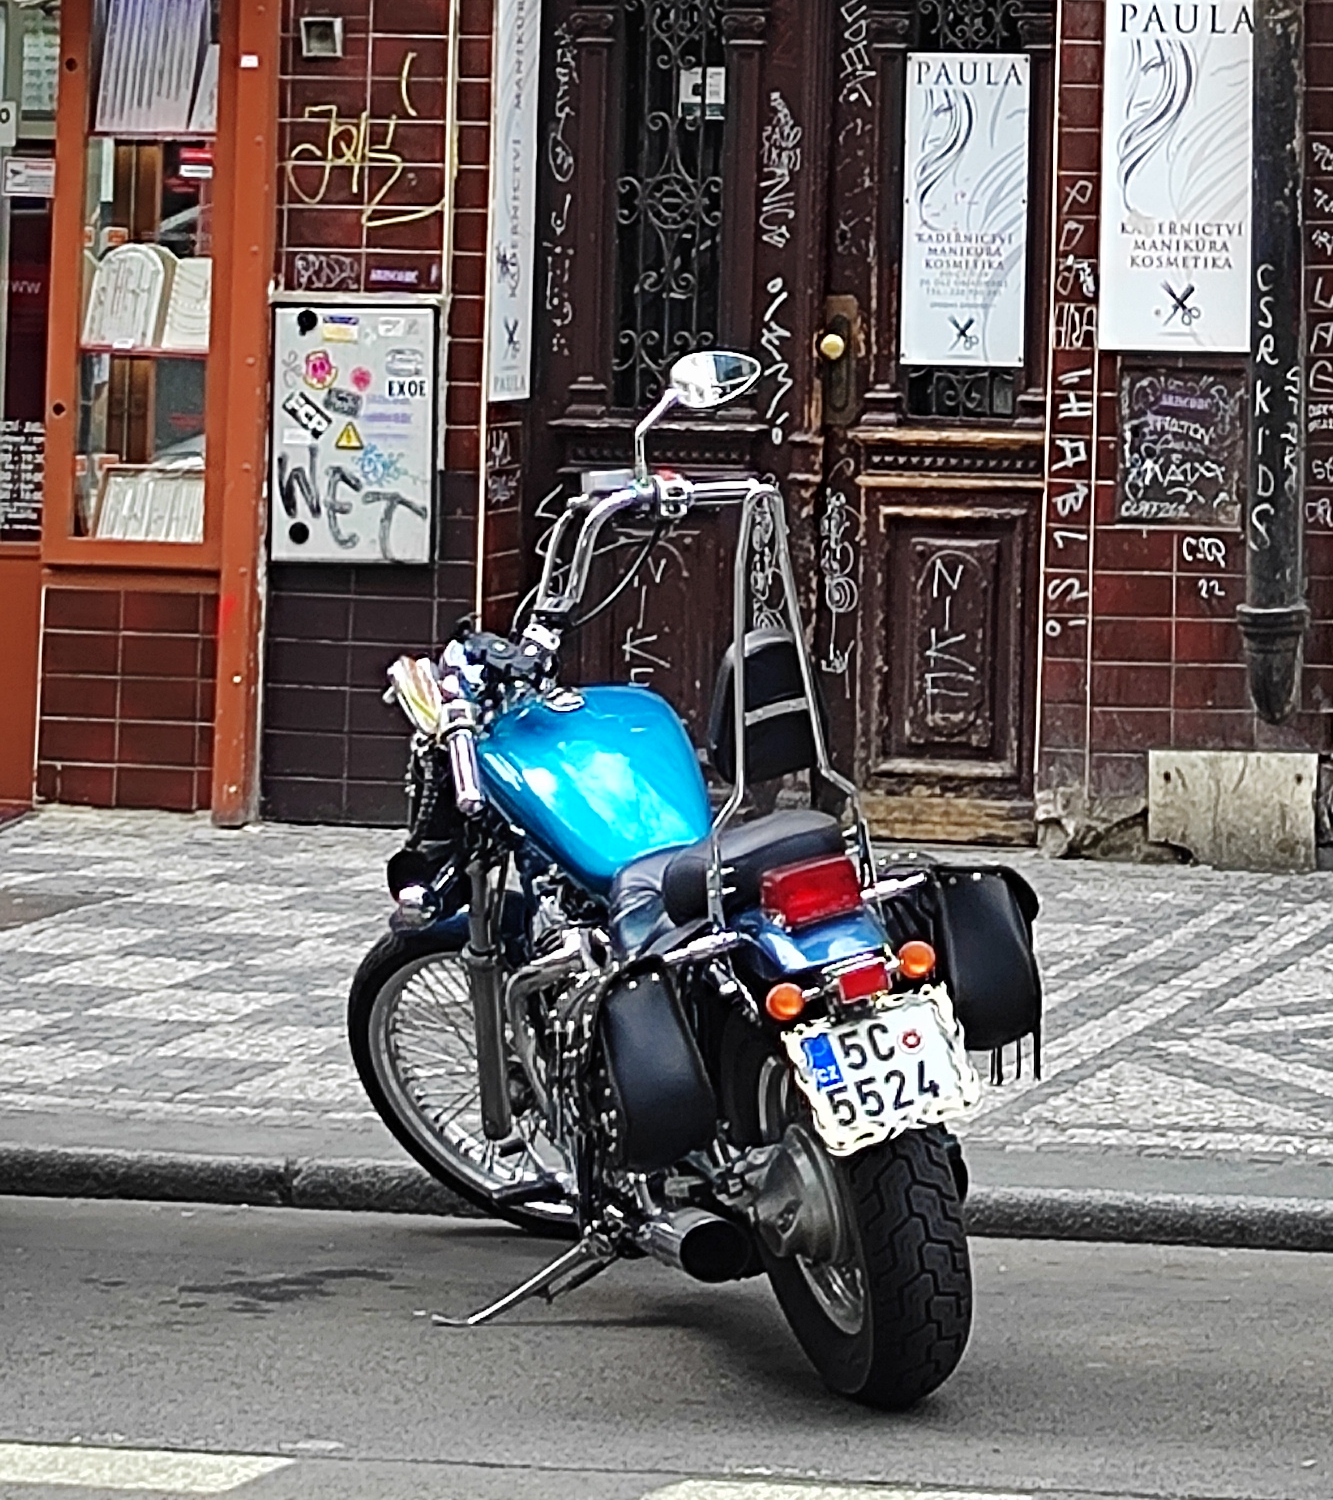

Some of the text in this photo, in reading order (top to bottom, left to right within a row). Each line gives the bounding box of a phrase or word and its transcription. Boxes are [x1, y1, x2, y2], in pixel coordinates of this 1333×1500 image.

[1119, 3, 1255, 35] PAULA
[915, 60, 1024, 88] PAULA
[1130, 254, 1233, 269] KOSMETIKA
[493, 375, 527, 393] PAULA
[838, 1023, 896, 1070] 5C
[818, 1065, 839, 1083] CZ
[826, 1060, 940, 1127] 5524
